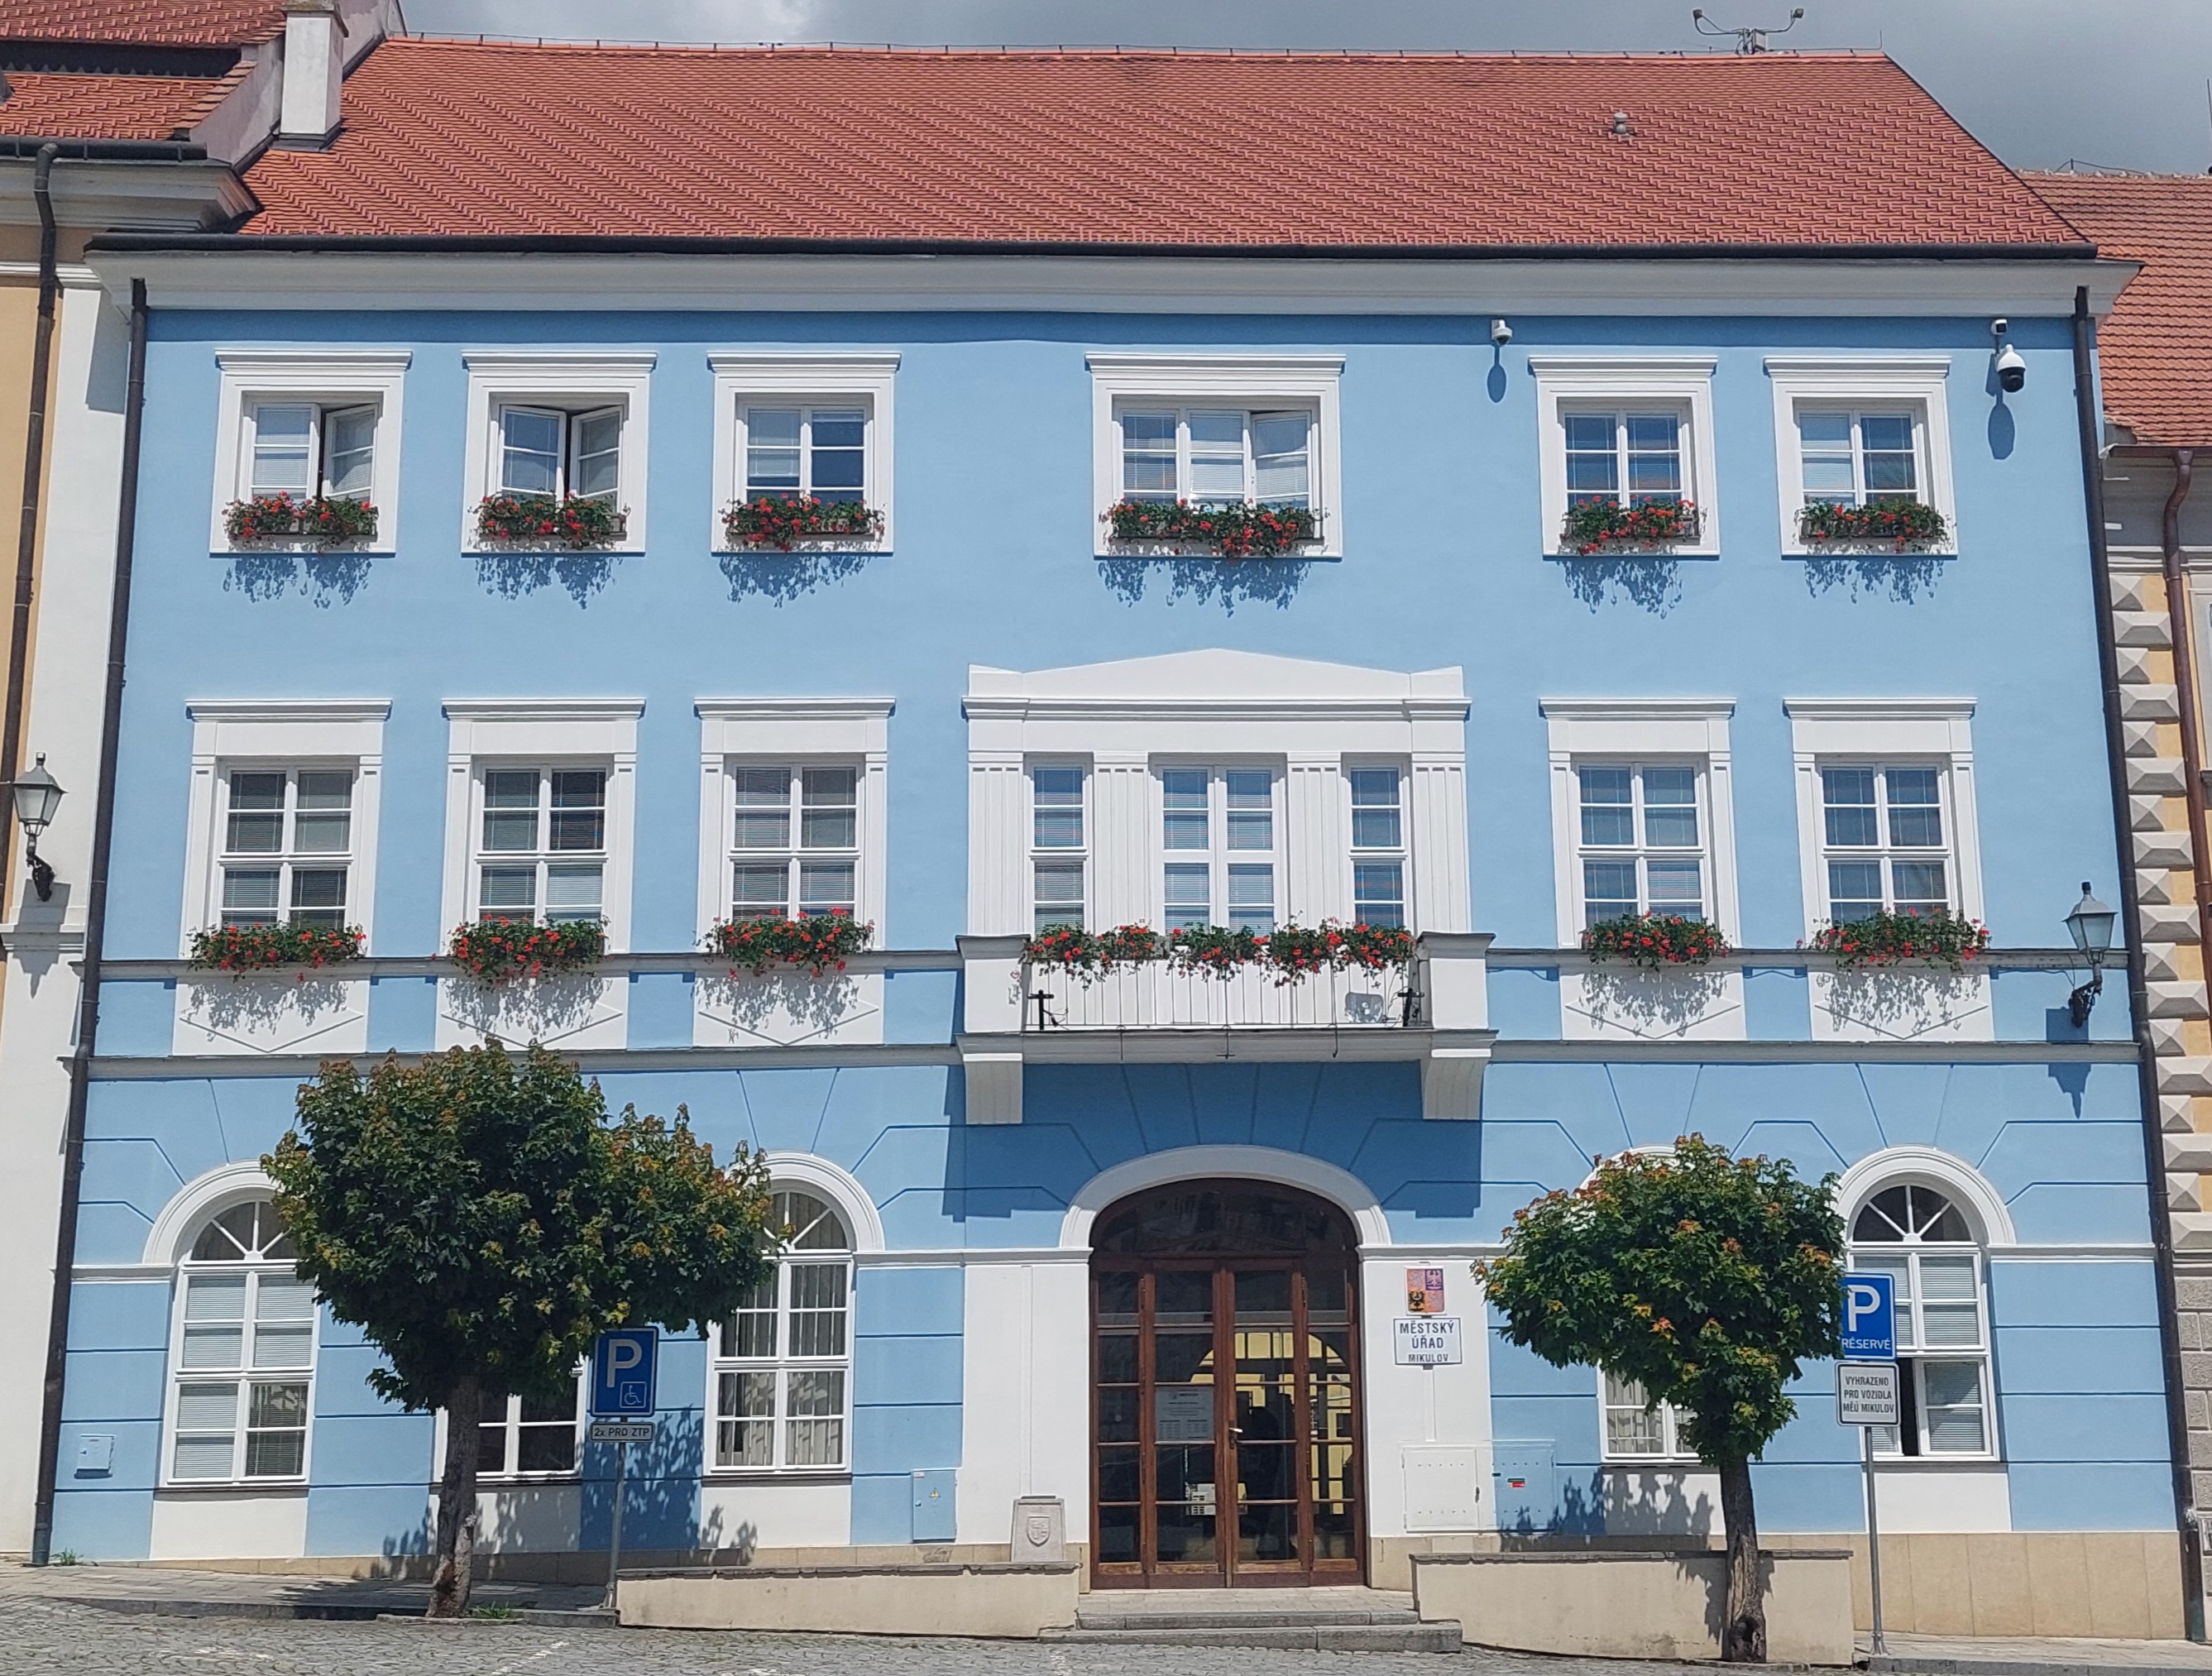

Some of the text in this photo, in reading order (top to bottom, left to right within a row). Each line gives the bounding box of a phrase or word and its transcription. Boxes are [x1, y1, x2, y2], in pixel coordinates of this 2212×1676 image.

[1847, 1285, 1880, 1332] P
[1400, 1319, 1454, 1334] MĚSTSKÝ
[1412, 1334, 1444, 1348] ÚŘAD
[1841, 1337, 1891, 1350] RÉSERVÉ
[606, 1338, 642, 1387] P
[1409, 1354, 1448, 1362] MIKULOV
[1845, 1377, 1889, 1386] VYHRAZENO
[1844, 1390, 1893, 1400] PRO VOZIDLA
[1861, 1403, 1894, 1414] MIKULOV
[594, 1428, 650, 1437] 2x PRO ZTP
